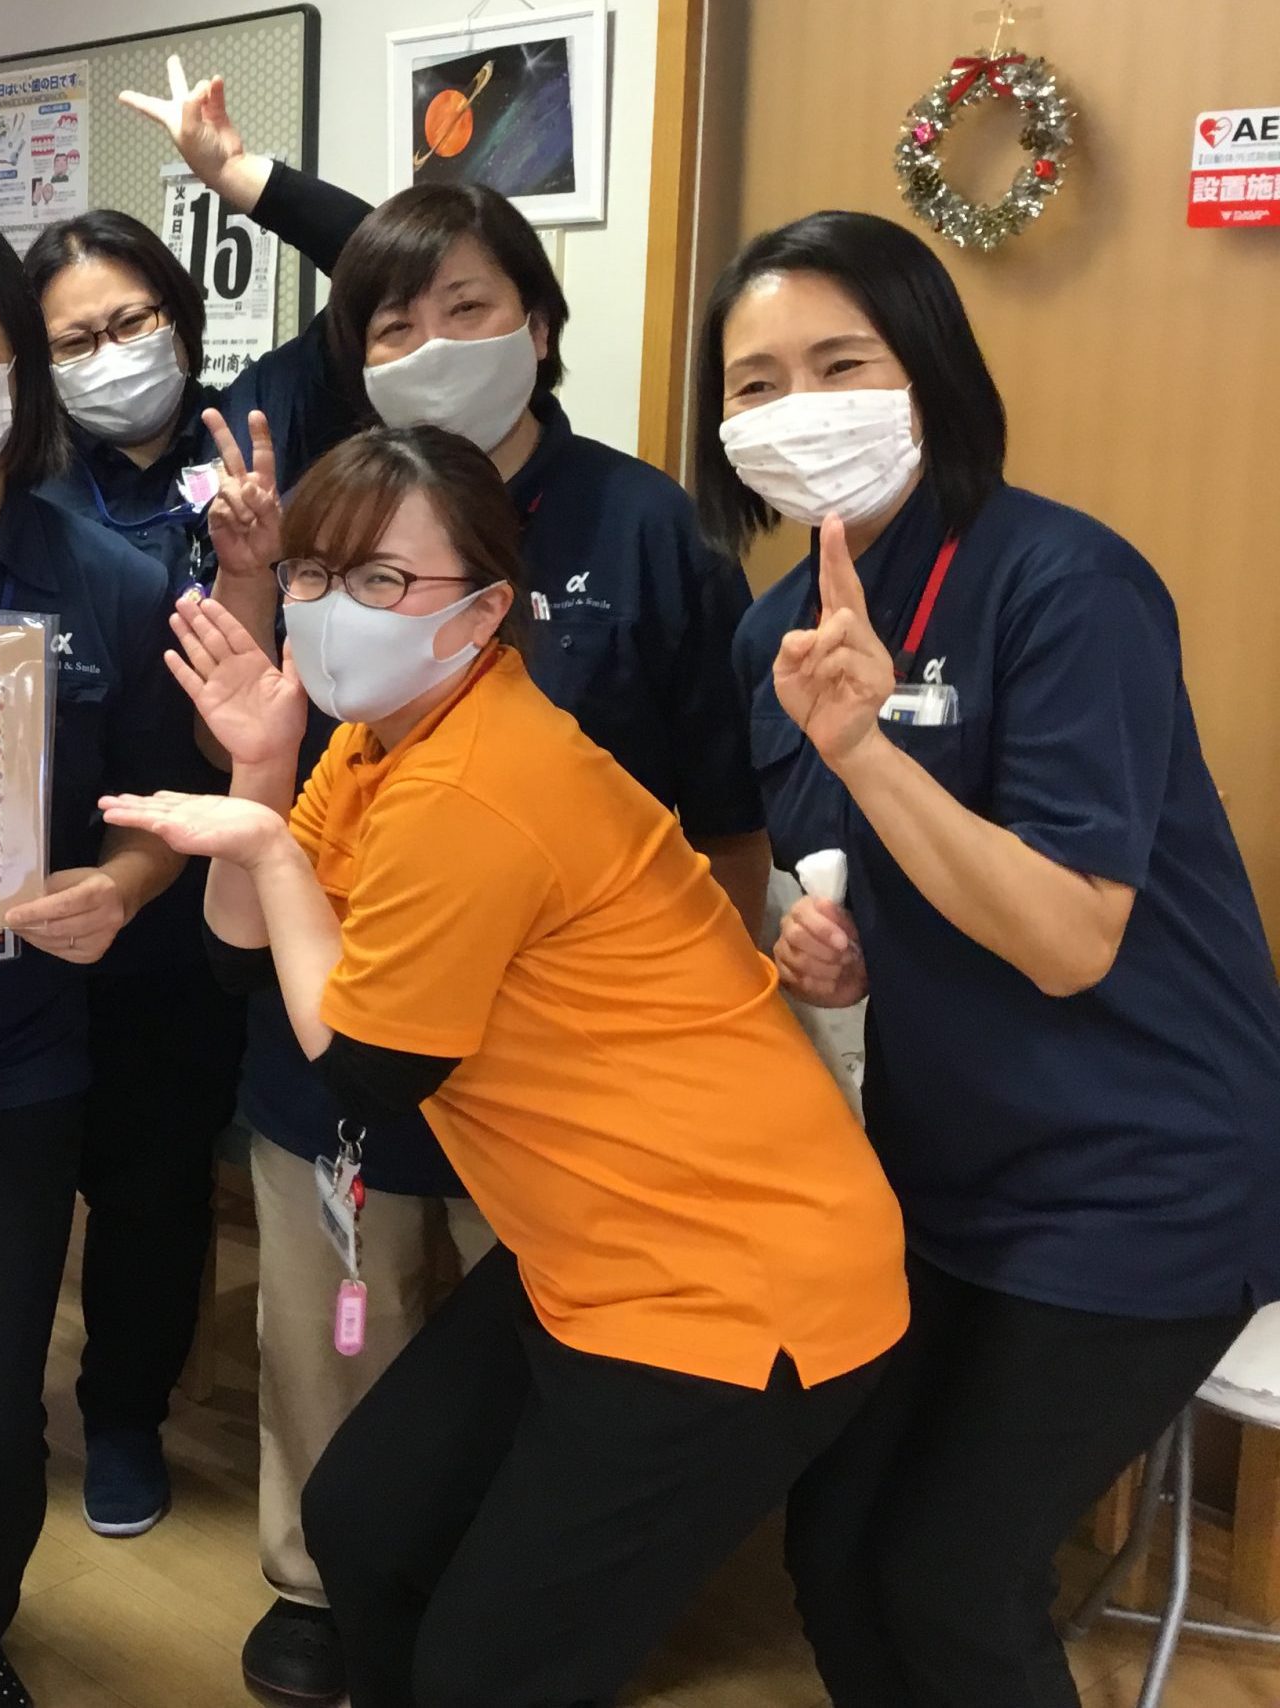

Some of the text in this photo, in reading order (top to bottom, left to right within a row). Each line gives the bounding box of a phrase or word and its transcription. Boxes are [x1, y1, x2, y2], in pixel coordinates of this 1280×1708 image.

[172, 185, 186, 234] 火曜日
[1192, 173, 1280, 203] 設置施
[190, 192, 252, 300] 15
